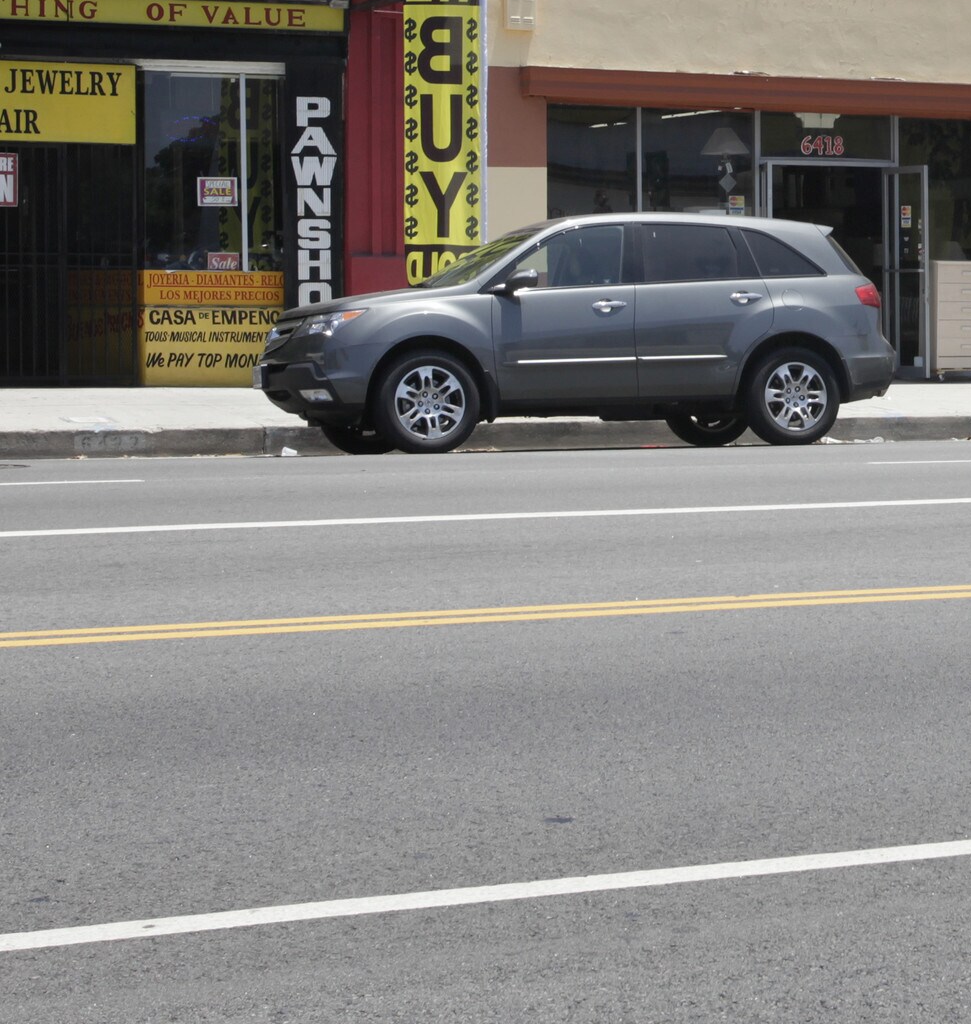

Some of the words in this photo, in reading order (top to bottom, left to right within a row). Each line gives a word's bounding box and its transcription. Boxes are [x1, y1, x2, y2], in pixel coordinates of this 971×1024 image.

[146, 3, 187, 22] OF
[202, 5, 306, 27] VALUE
[4, 68, 122, 96] JEWELRY
[800, 135, 844, 155] 6418
[203, 188, 232, 196] SALE
[209, 257, 237, 270] Sale
[147, 274, 190, 289] JOYERIA
[197, 274, 254, 286] DIAMANTES
[160, 290, 180, 301] LOS
[184, 290, 232, 303] MEJORES
[234, 290, 280, 301] PRECIOS
[149, 309, 197, 325] CASA
[198, 312, 210, 320] DE
[168, 331, 207, 343] MUSICAL
[167, 352, 195, 368] PAY
[197, 353, 223, 368] TOP
[225, 353, 262, 369] MON
